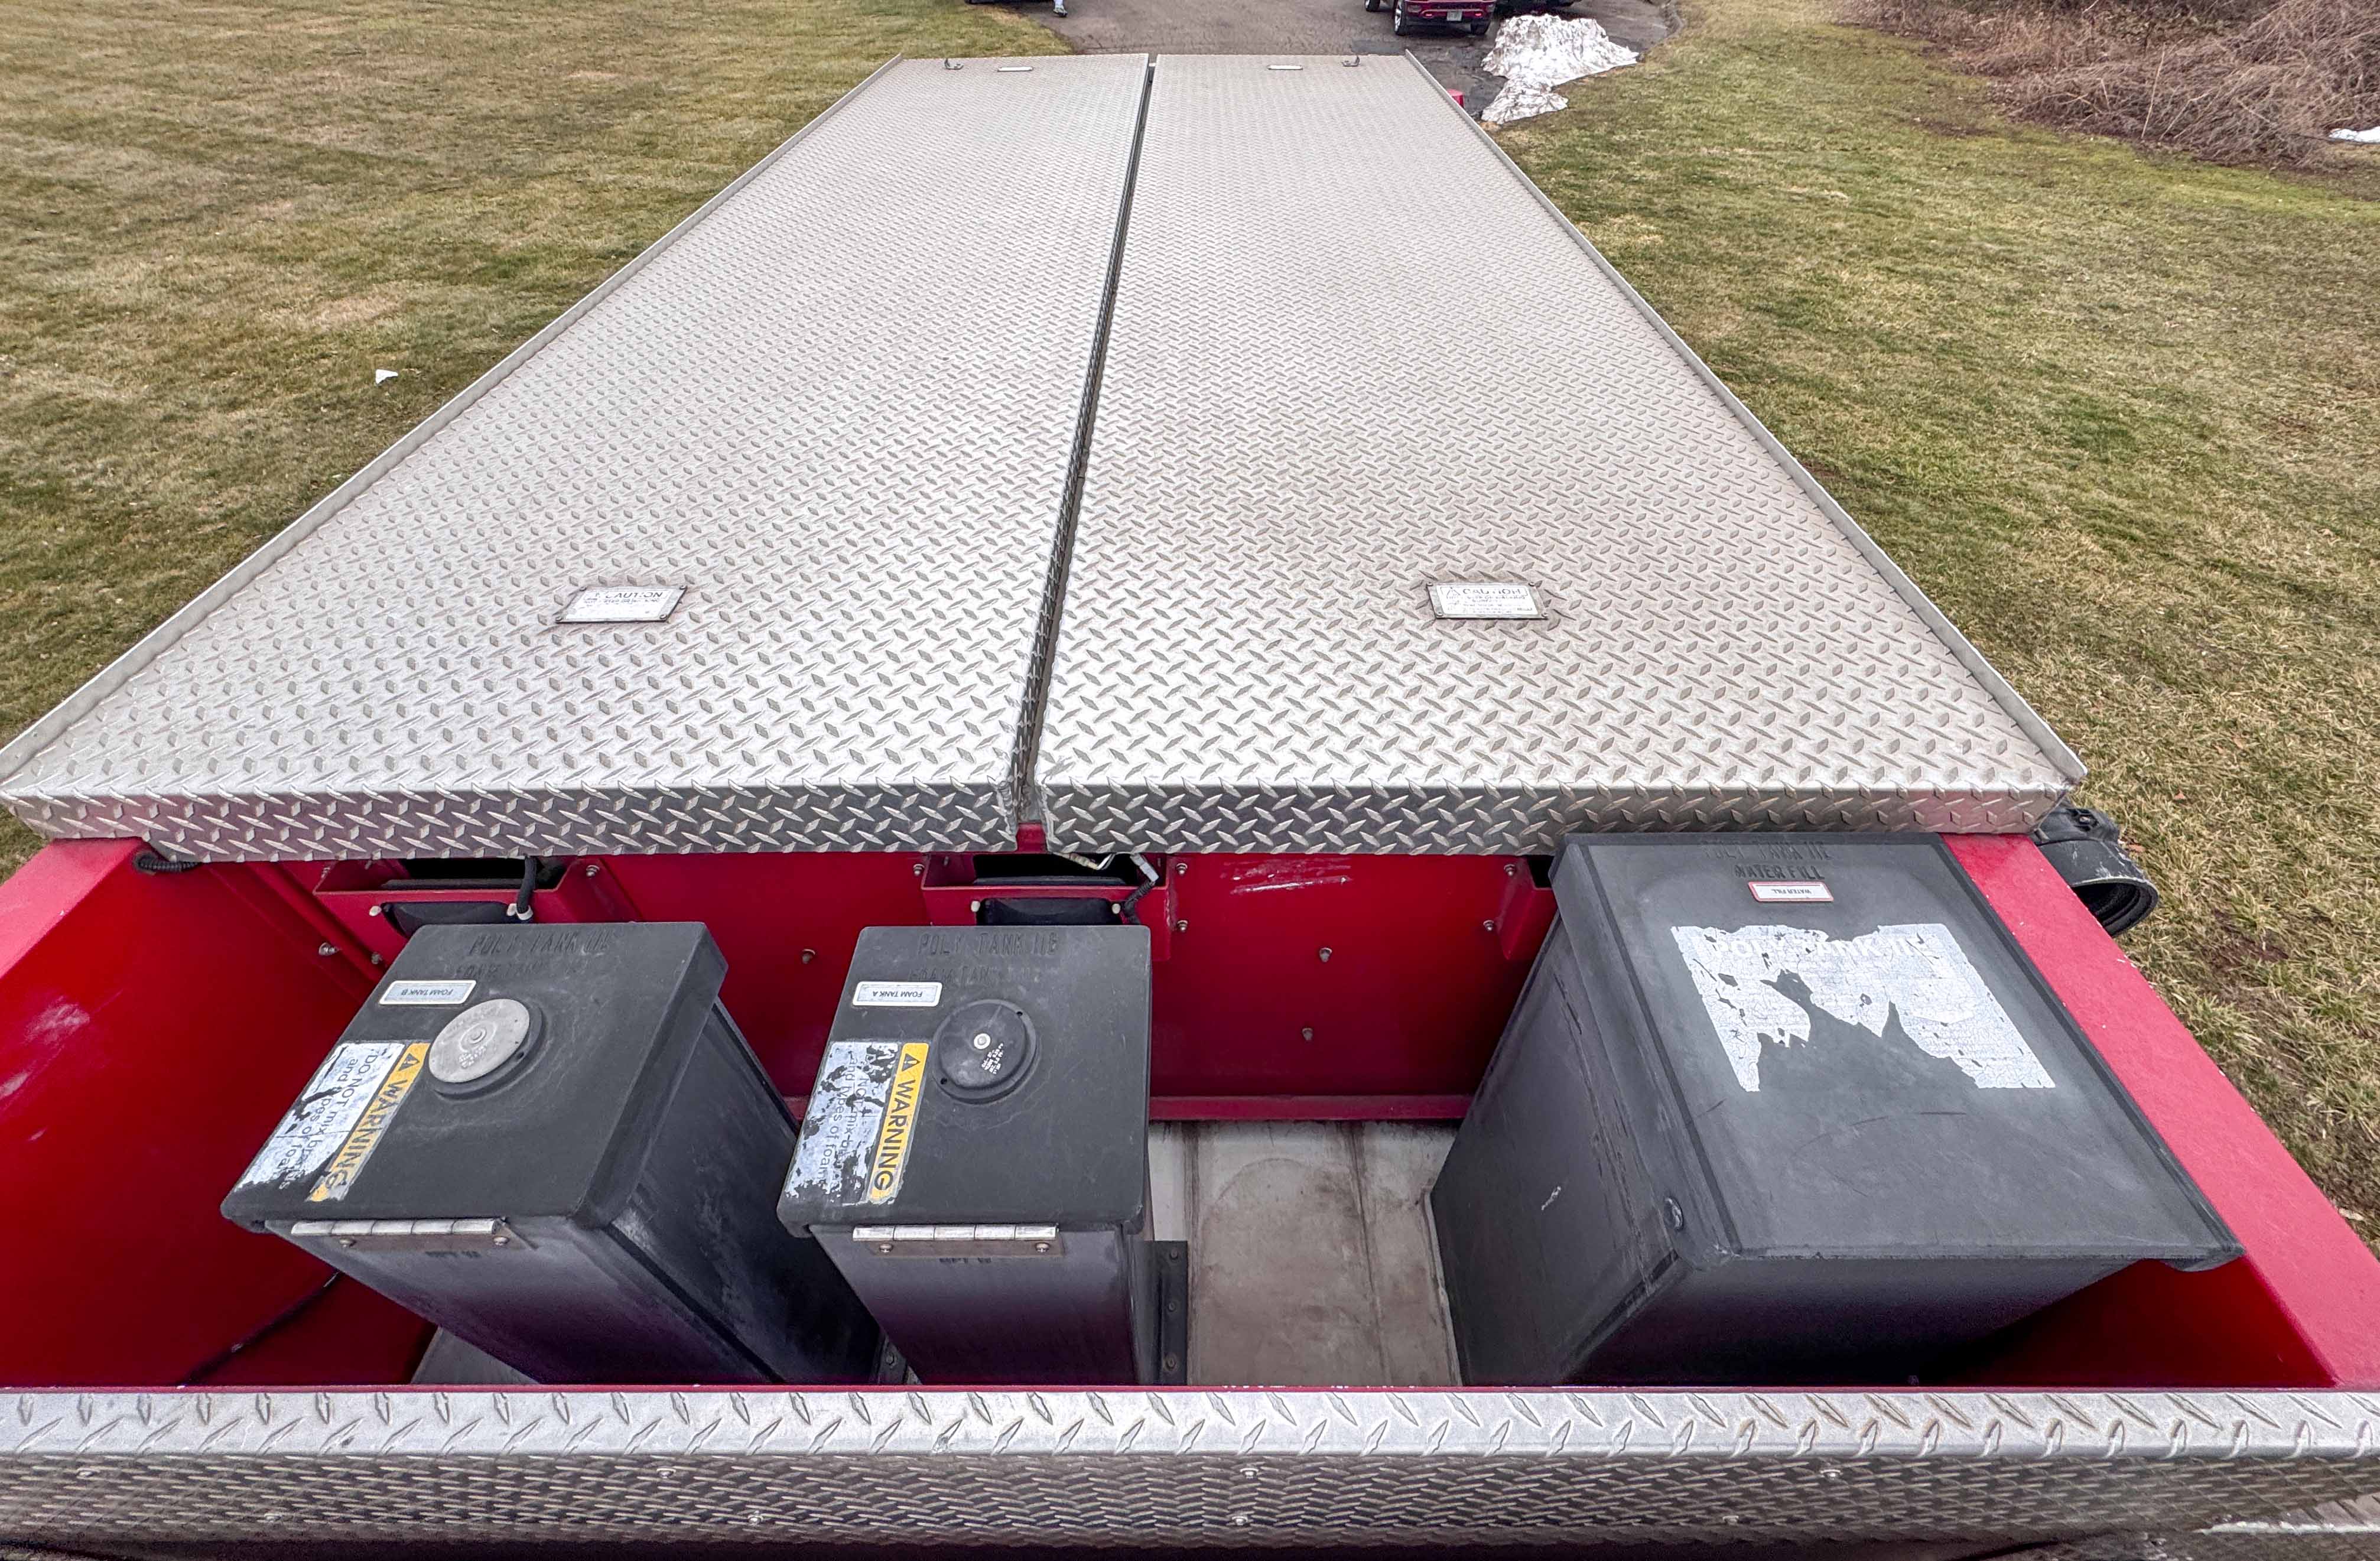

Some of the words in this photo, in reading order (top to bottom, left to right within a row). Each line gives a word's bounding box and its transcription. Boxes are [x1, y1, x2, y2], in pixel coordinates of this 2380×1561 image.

[1734, 864, 1786, 879] WATER
[1787, 864, 1826, 880] FILL
[337, 1058, 359, 1082] and
[357, 1054, 379, 1075] DO
[336, 1077, 363, 1107] NOT
[297, 1126, 313, 1140] of
[317, 1110, 339, 1136] mix
[325, 1079, 409, 1189] WARNING
[827, 1126, 840, 1140] of
[874, 1079, 916, 1191] WARNING
[817, 1143, 837, 1183] foam
